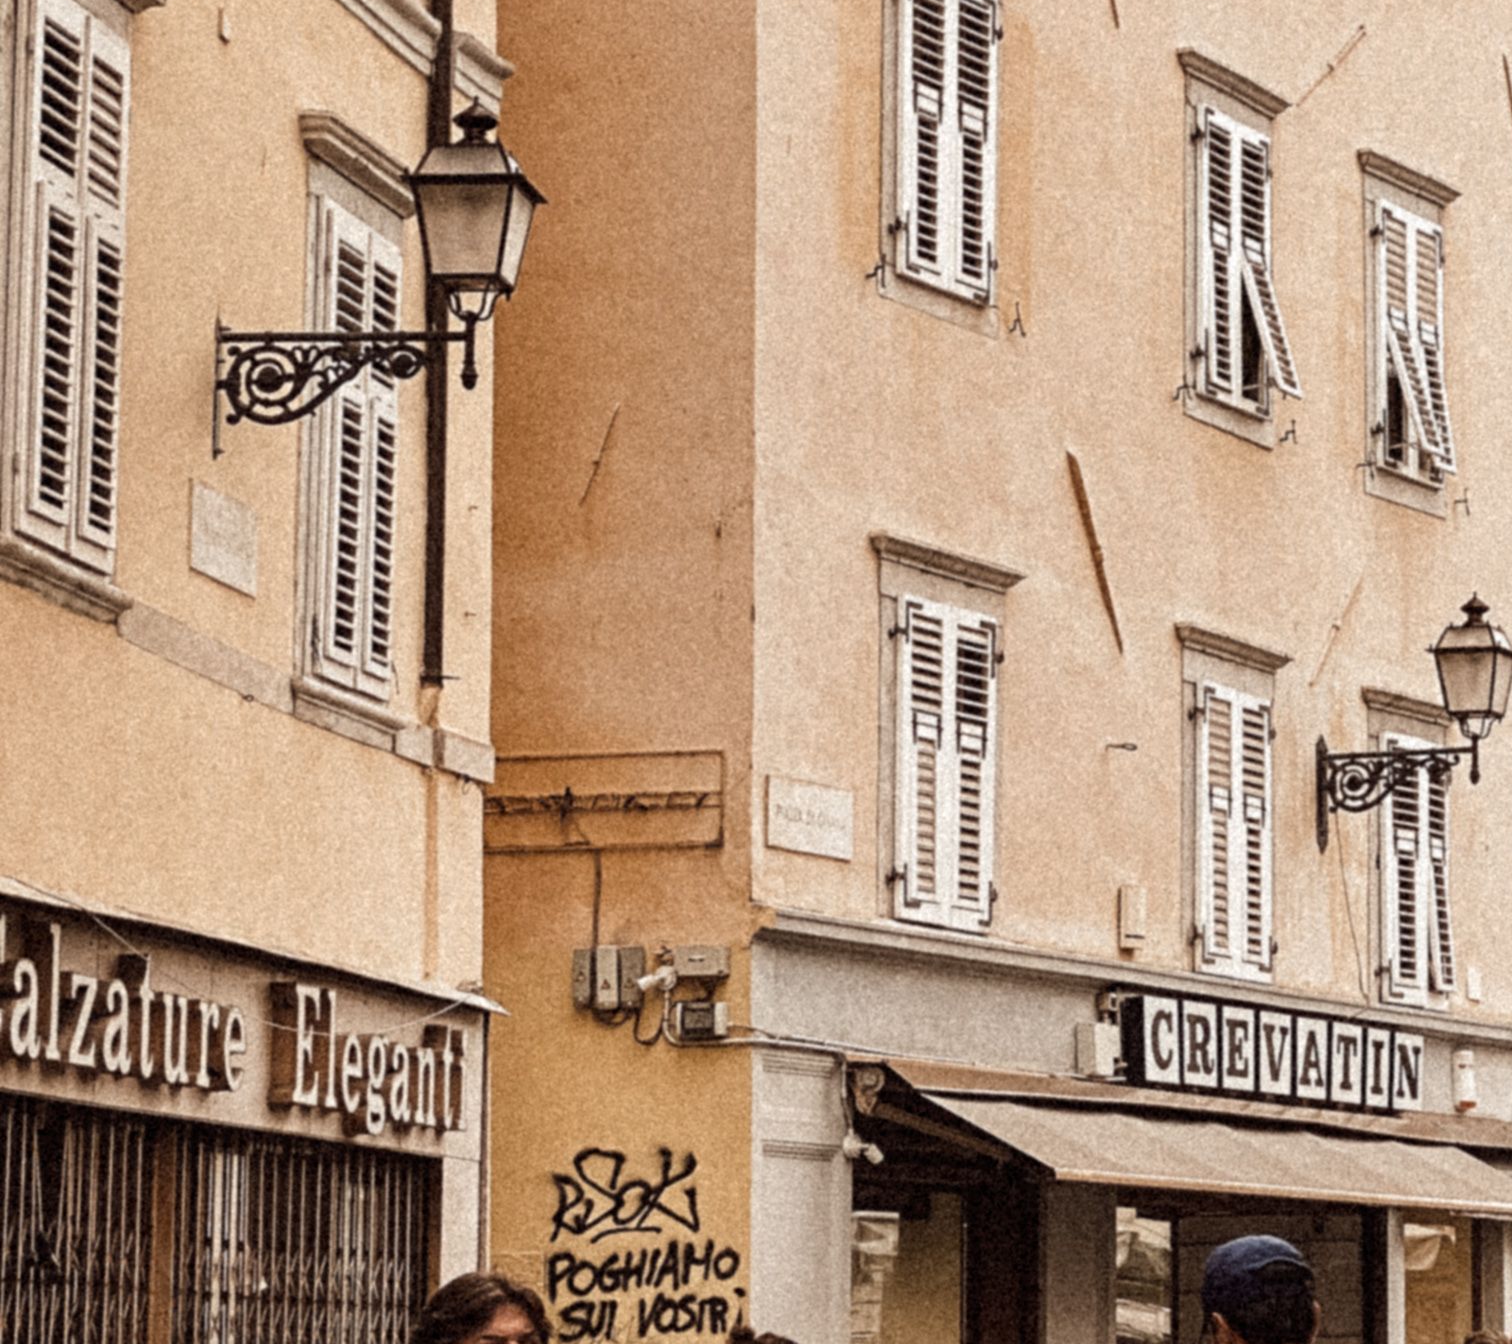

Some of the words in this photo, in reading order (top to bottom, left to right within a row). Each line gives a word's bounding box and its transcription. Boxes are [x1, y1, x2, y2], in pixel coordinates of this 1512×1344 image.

[0, 914, 247, 1091] alzature
[293, 985, 468, 1135] Eleganti
[1151, 1009, 1421, 1099] CREVATIN
[549, 1239, 740, 1304] POGHIAMO
[558, 1300, 618, 1342] SUI
